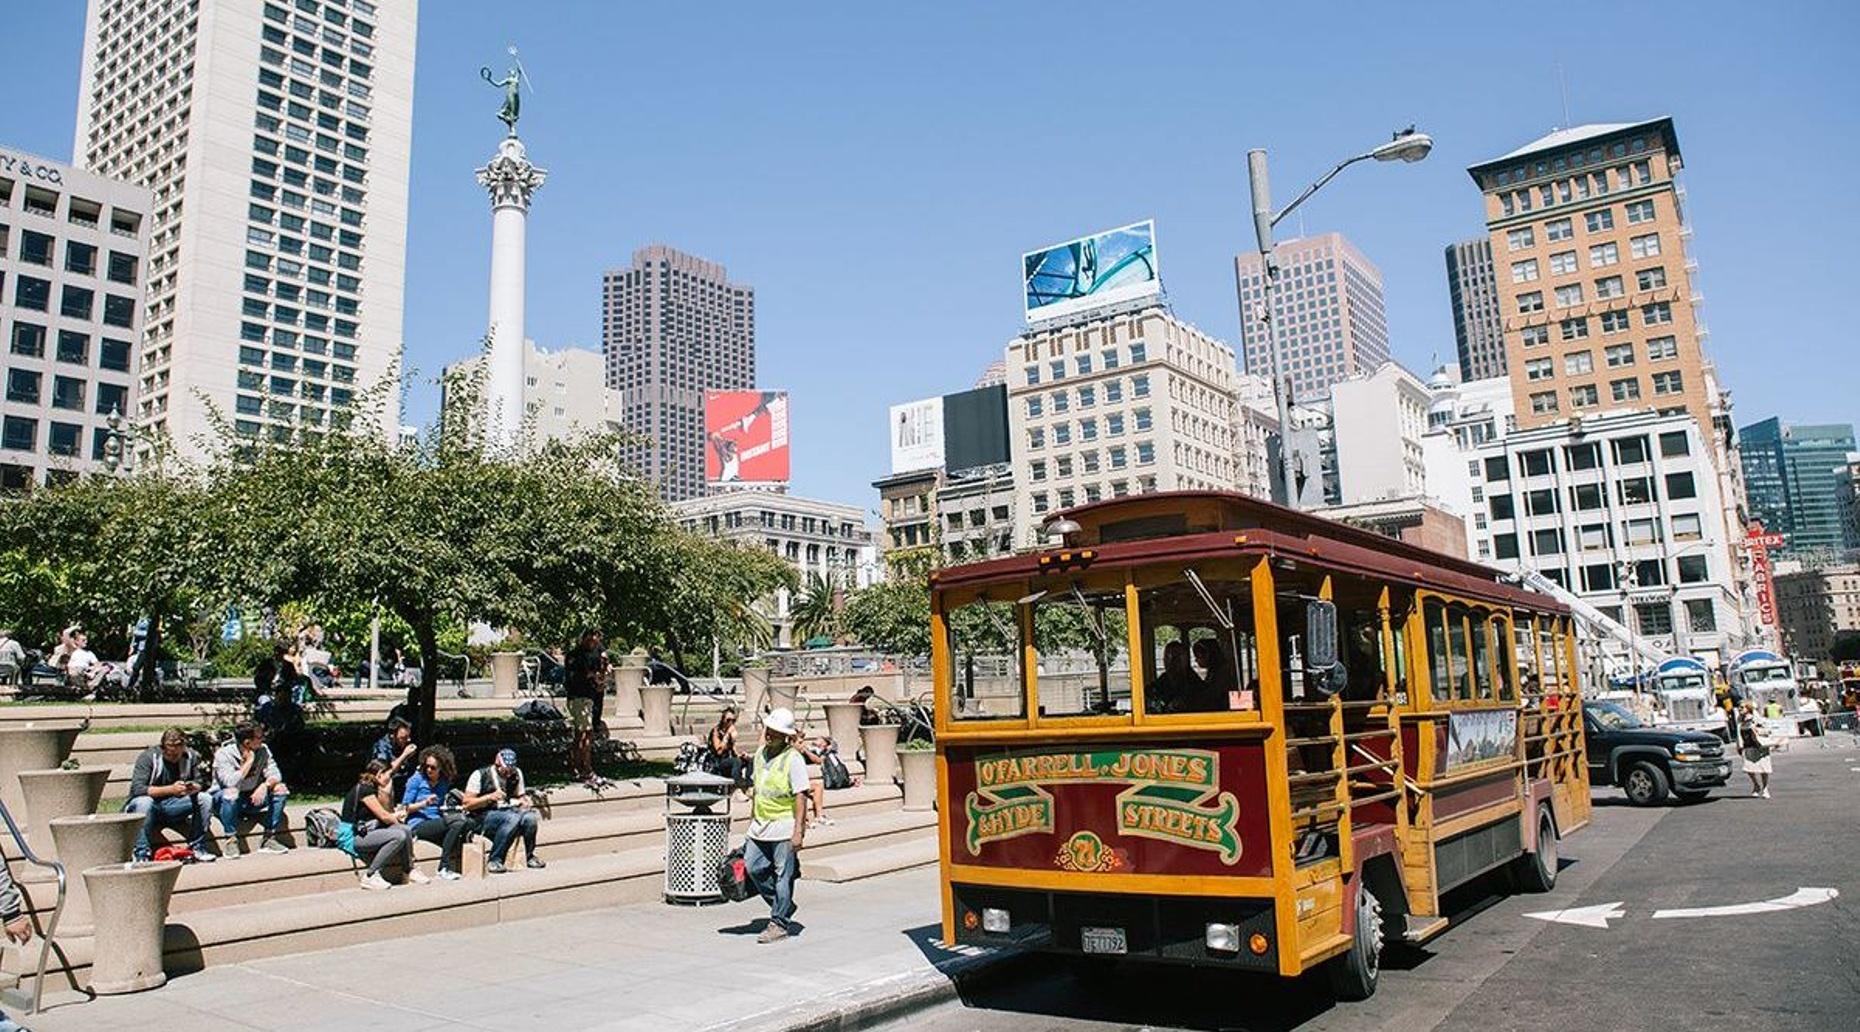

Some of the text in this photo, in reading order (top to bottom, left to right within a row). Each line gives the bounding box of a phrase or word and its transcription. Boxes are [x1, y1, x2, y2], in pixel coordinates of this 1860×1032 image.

[20, 161, 32, 177] &
[1110, 753, 1207, 782] JONES
[1124, 803, 1222, 843] STREETS
